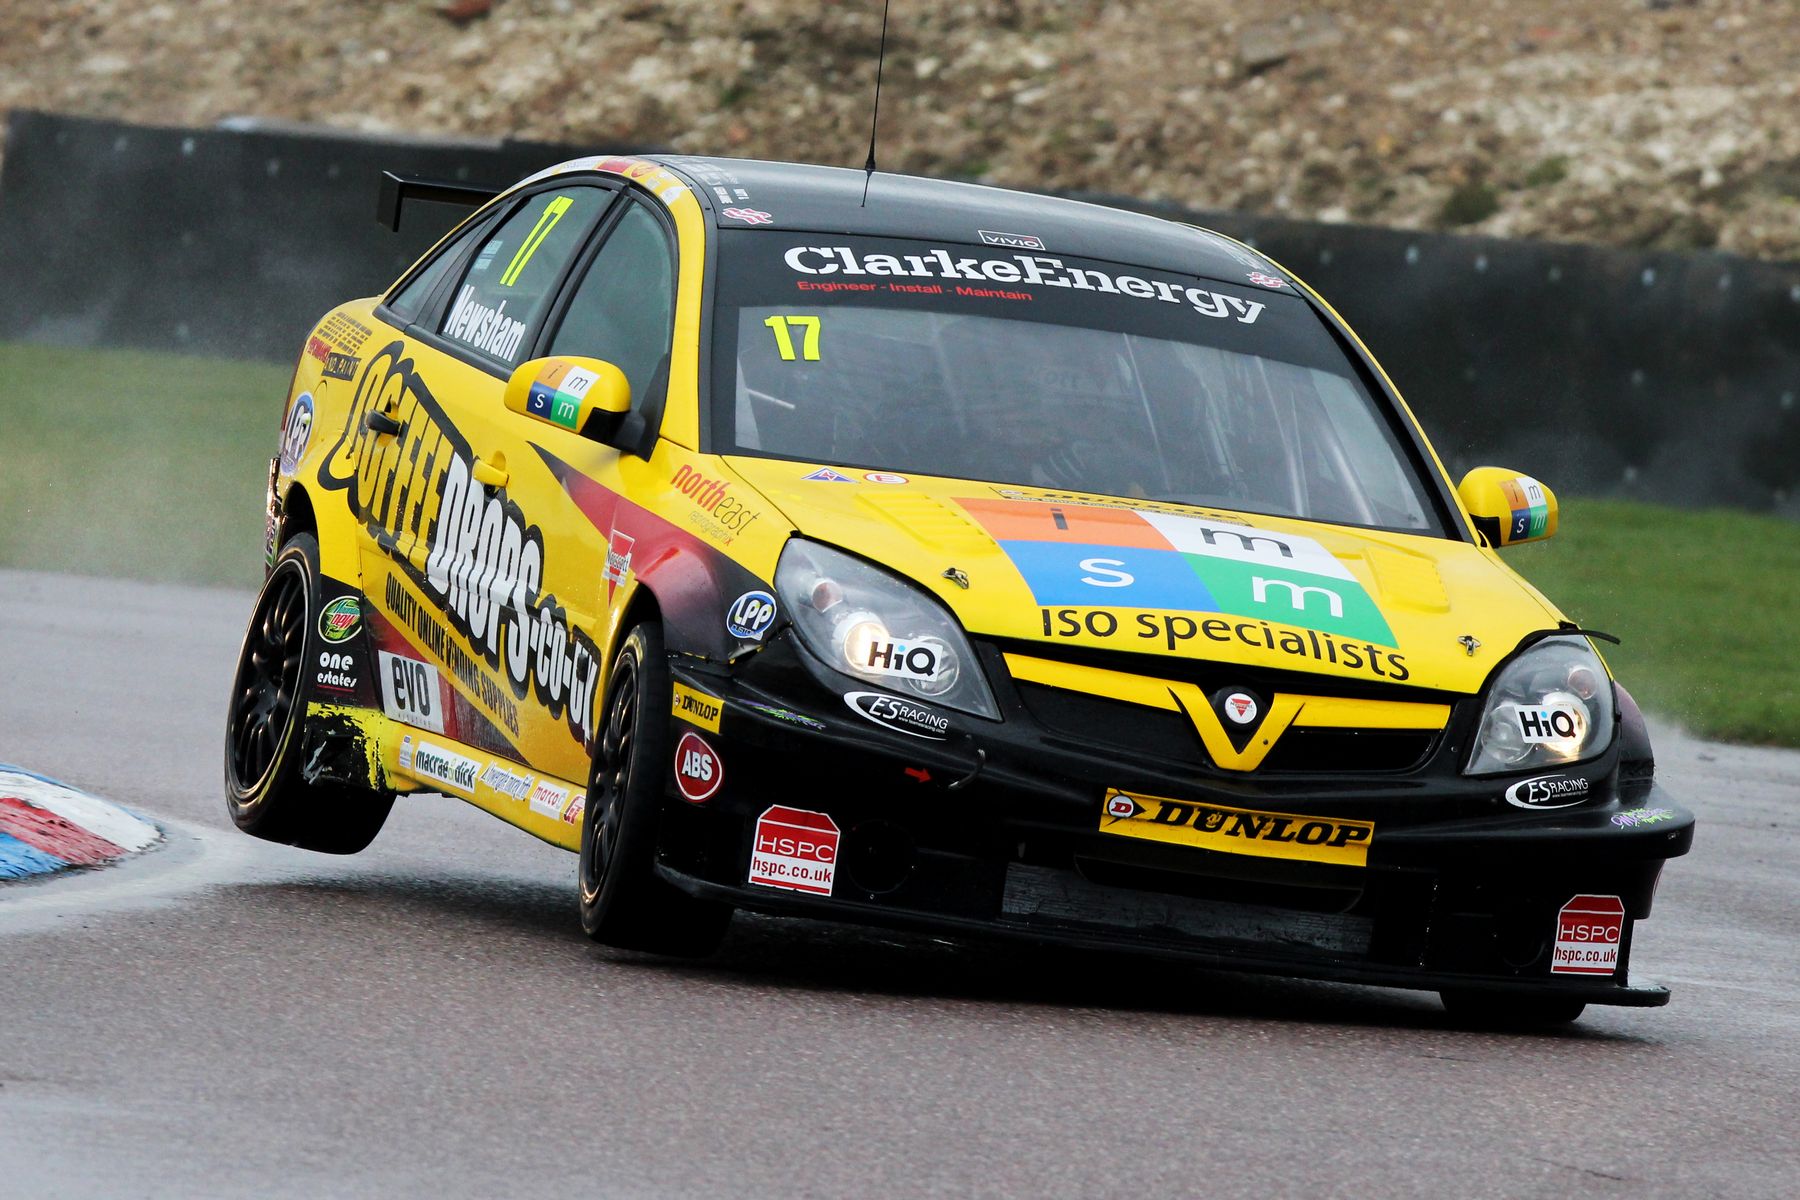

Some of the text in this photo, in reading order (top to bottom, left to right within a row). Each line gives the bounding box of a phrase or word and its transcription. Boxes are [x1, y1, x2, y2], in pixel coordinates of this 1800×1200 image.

[500, 196, 574, 286] 17
[985, 235, 1039, 248] VIVIO
[784, 246, 1266, 324] ClarkeEnergy
[797, 281, 1033, 301] Engineer Install Maintain
[444, 284, 526, 362] Newsham
[765, 316, 821, 361] 17
[568, 376, 589, 391] m
[534, 394, 575, 419] s m
[1528, 485, 1541, 500] m
[1050, 508, 1069, 530] i
[1200, 527, 1293, 558] m
[1534, 512, 1546, 530] m
[1079, 558, 1343, 618] s m
[734, 596, 773, 631] LPP
[320, 652, 353, 671] one
[385, 571, 418, 632] QUALITY
[417, 605, 445, 661] ONLINE
[446, 632, 481, 700] VENDING
[480, 670, 520, 739] SUPPLIES
[868, 641, 936, 677] HiQ
[1136, 614, 1410, 681] specialists
[317, 671, 357, 688] estates
[391, 656, 431, 717] evo
[682, 695, 719, 722] DUNLOP
[868, 697, 949, 730] ES RACING
[1519, 710, 1577, 739] HiQ
[681, 749, 713, 782] ABS
[1528, 780, 1550, 803] ES
[1550, 778, 1589, 794] RACING
[1148, 801, 1372, 848] DUNLOP
[758, 835, 834, 862] HSPC
[752, 856, 832, 883] hspc.co.uk
[1560, 924, 1619, 942] HSPC
[1554, 946, 1617, 964] hspc.co.uk
